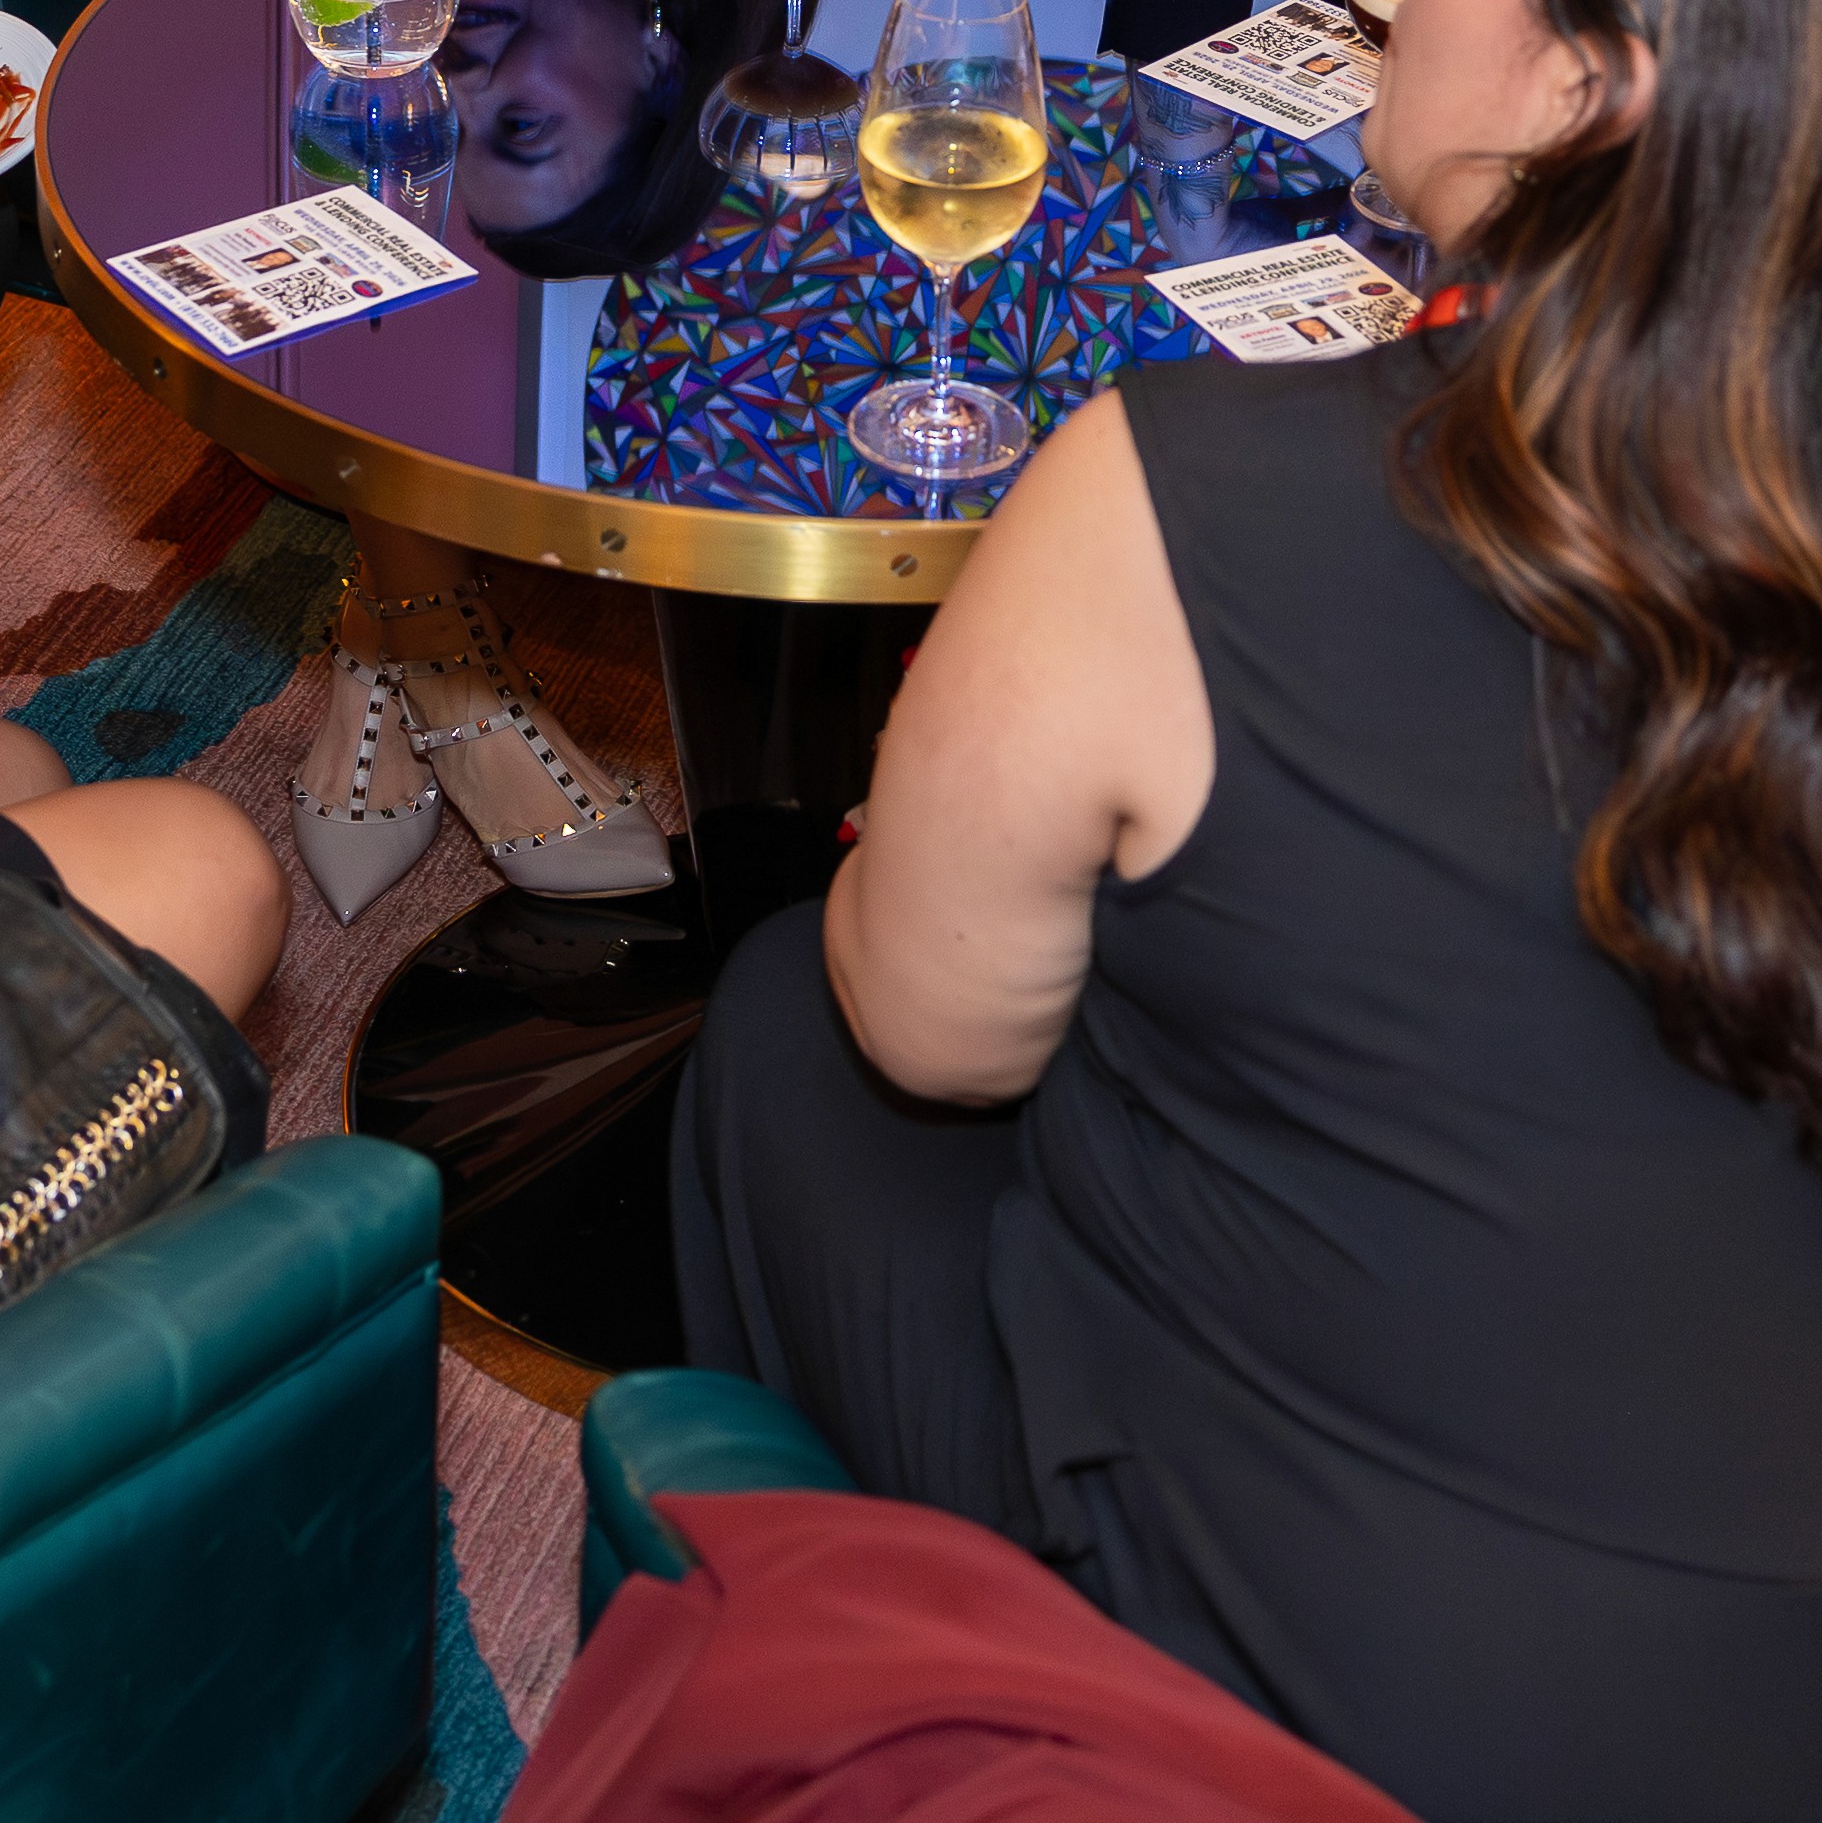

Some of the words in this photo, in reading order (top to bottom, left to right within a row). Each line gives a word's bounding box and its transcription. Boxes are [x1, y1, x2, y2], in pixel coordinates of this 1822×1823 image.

[1162, 62, 1207, 82] ESTATE
[1171, 57, 1256, 94] CONFERENCE
[1204, 79, 1239, 95] REAL
[1237, 69, 1270, 84] APRIL
[1235, 92, 1317, 127] COMMERCIAL
[1254, 91, 1316, 118] LENDING
[321, 204, 370, 235] LENDING
[363, 233, 435, 281] CONFERENCE
[327, 195, 389, 237] COMMERCIAL
[383, 234, 414, 253] REAL
[407, 251, 449, 277] ESTATE
[1169, 267, 1262, 291] COMMERCIAL
[1260, 259, 1297, 271] REAL
[1296, 248, 1347, 263] ESTATE
[1189, 276, 1260, 296] LENDING
[1257, 255, 1356, 280] CONFERENCE
